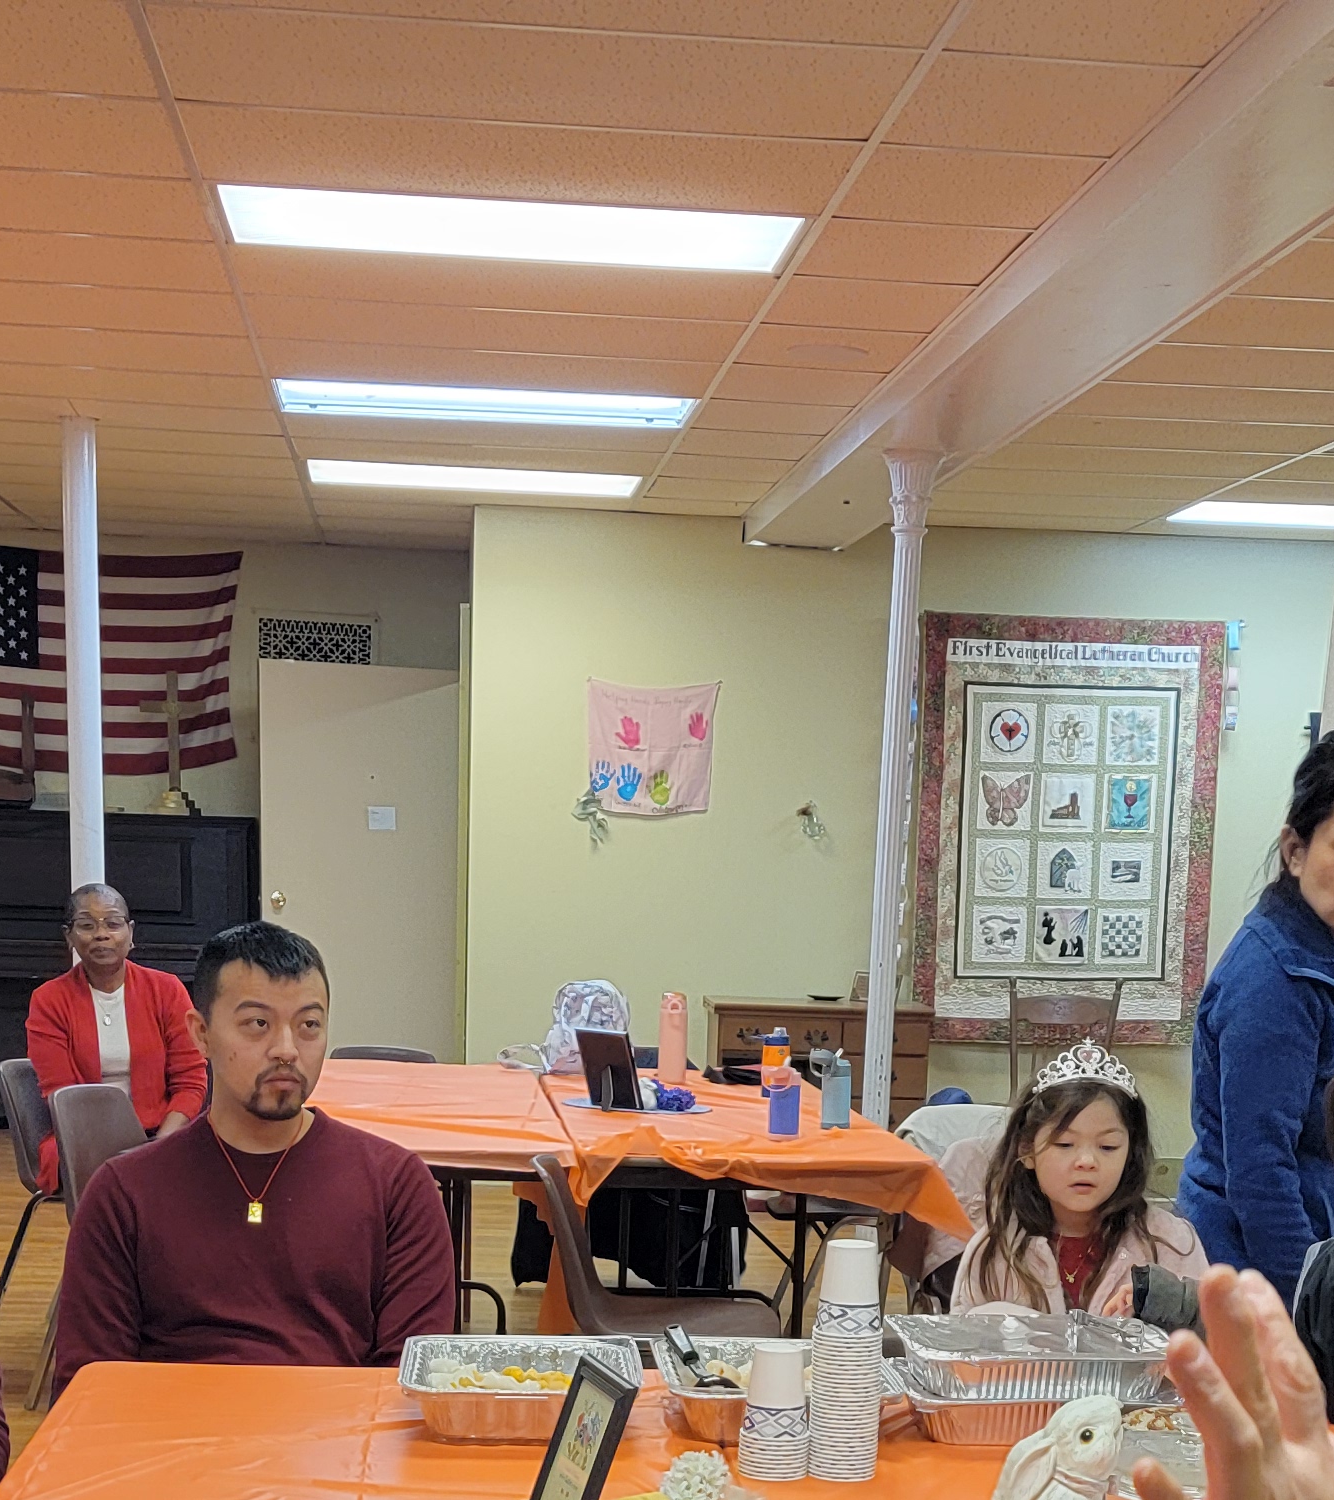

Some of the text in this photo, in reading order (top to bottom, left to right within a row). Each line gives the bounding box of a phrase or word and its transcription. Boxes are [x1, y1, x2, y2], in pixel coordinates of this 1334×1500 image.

[950, 639, 1200, 664] First Evangelical Lutheran Church
